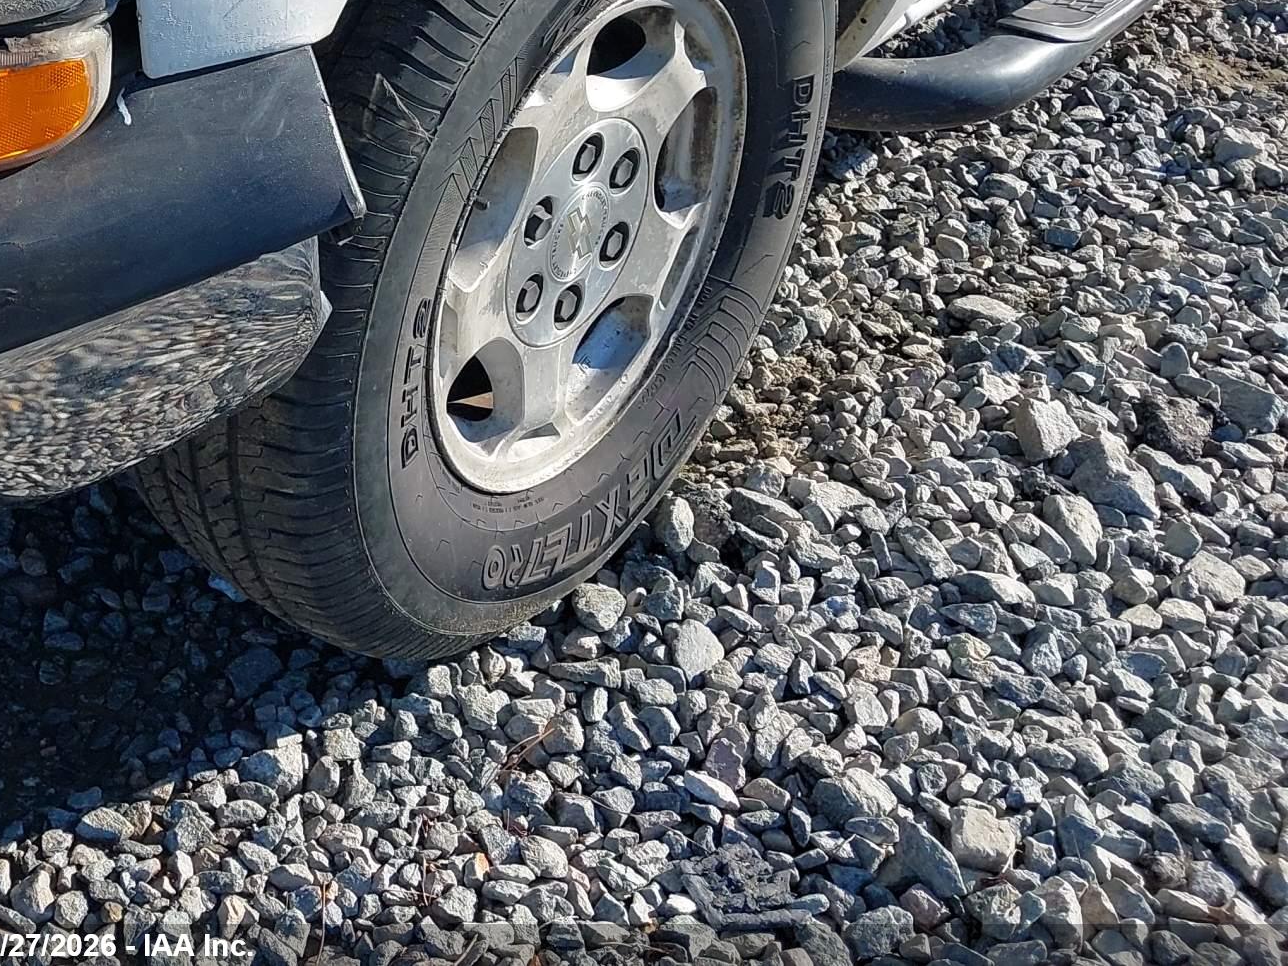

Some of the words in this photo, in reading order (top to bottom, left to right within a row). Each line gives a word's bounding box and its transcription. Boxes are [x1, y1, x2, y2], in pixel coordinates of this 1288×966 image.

[773, 74, 815, 220] DHT2
[401, 298, 432, 470] DHT2
[482, 408, 698, 590] DEXTERO
